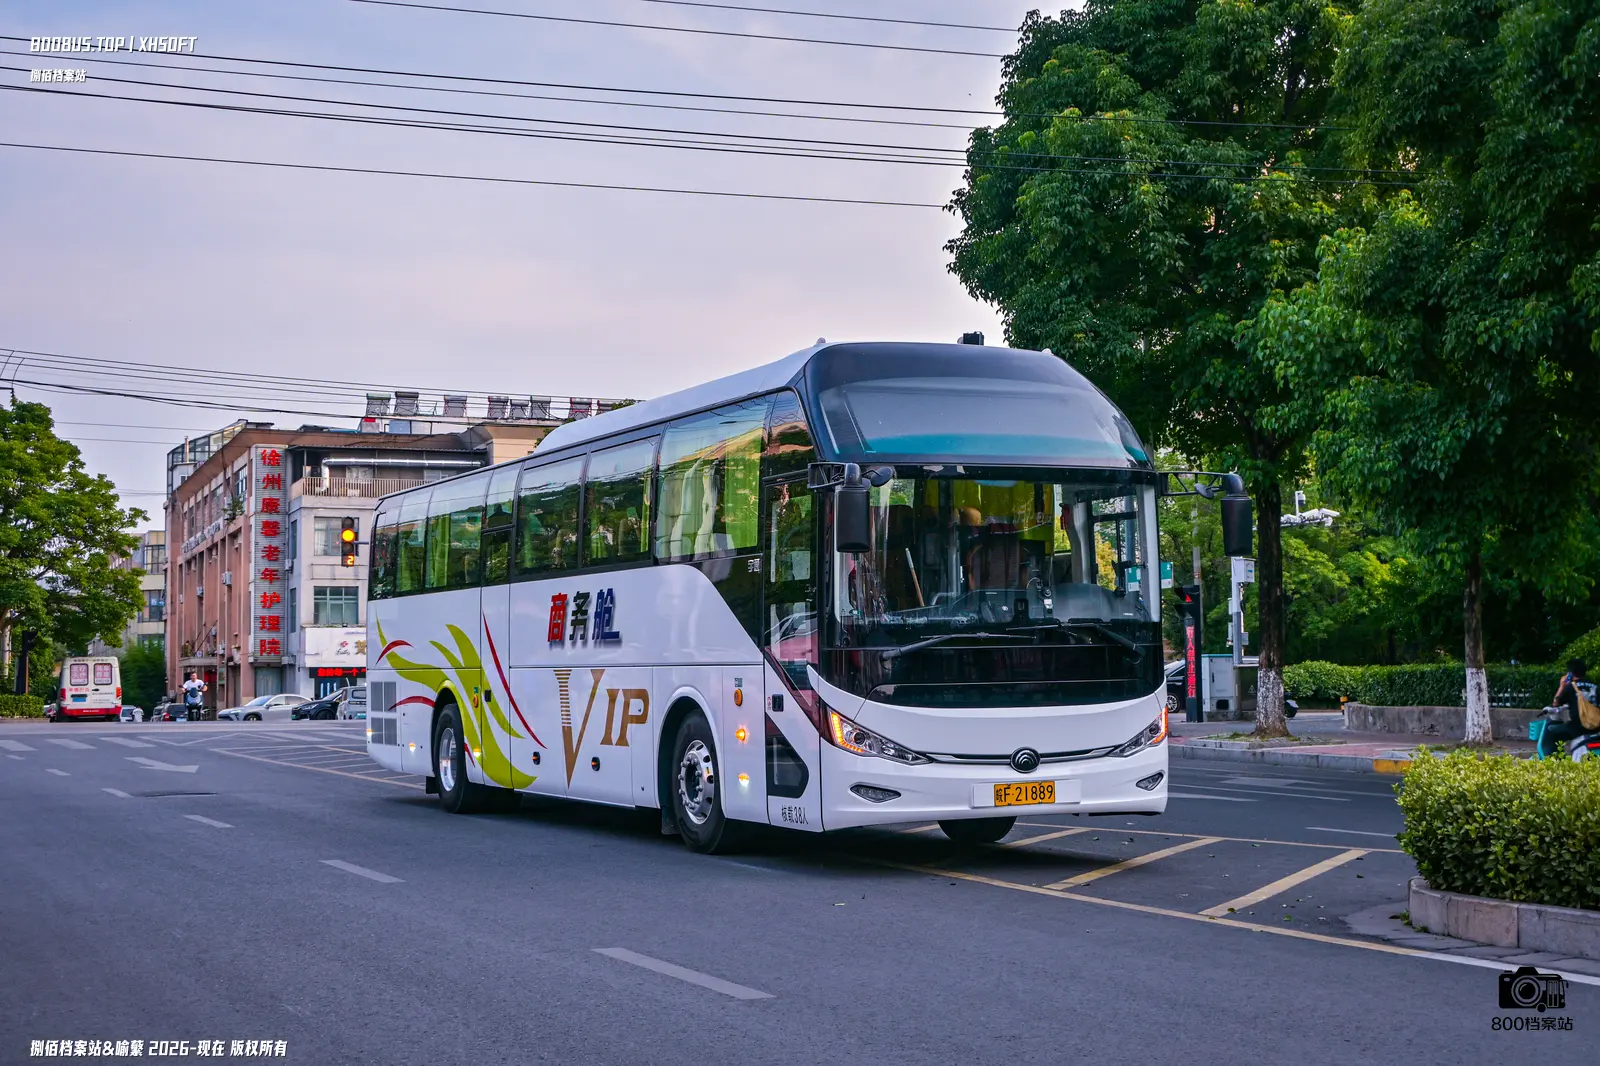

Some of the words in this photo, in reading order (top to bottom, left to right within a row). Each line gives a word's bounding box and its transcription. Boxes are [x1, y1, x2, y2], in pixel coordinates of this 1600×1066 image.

[347, 555, 354, 565] 2
[547, 588, 620, 642] 商务舱
[553, 669, 649, 789] VIP
[781, 805, 808, 825] 核载38人
